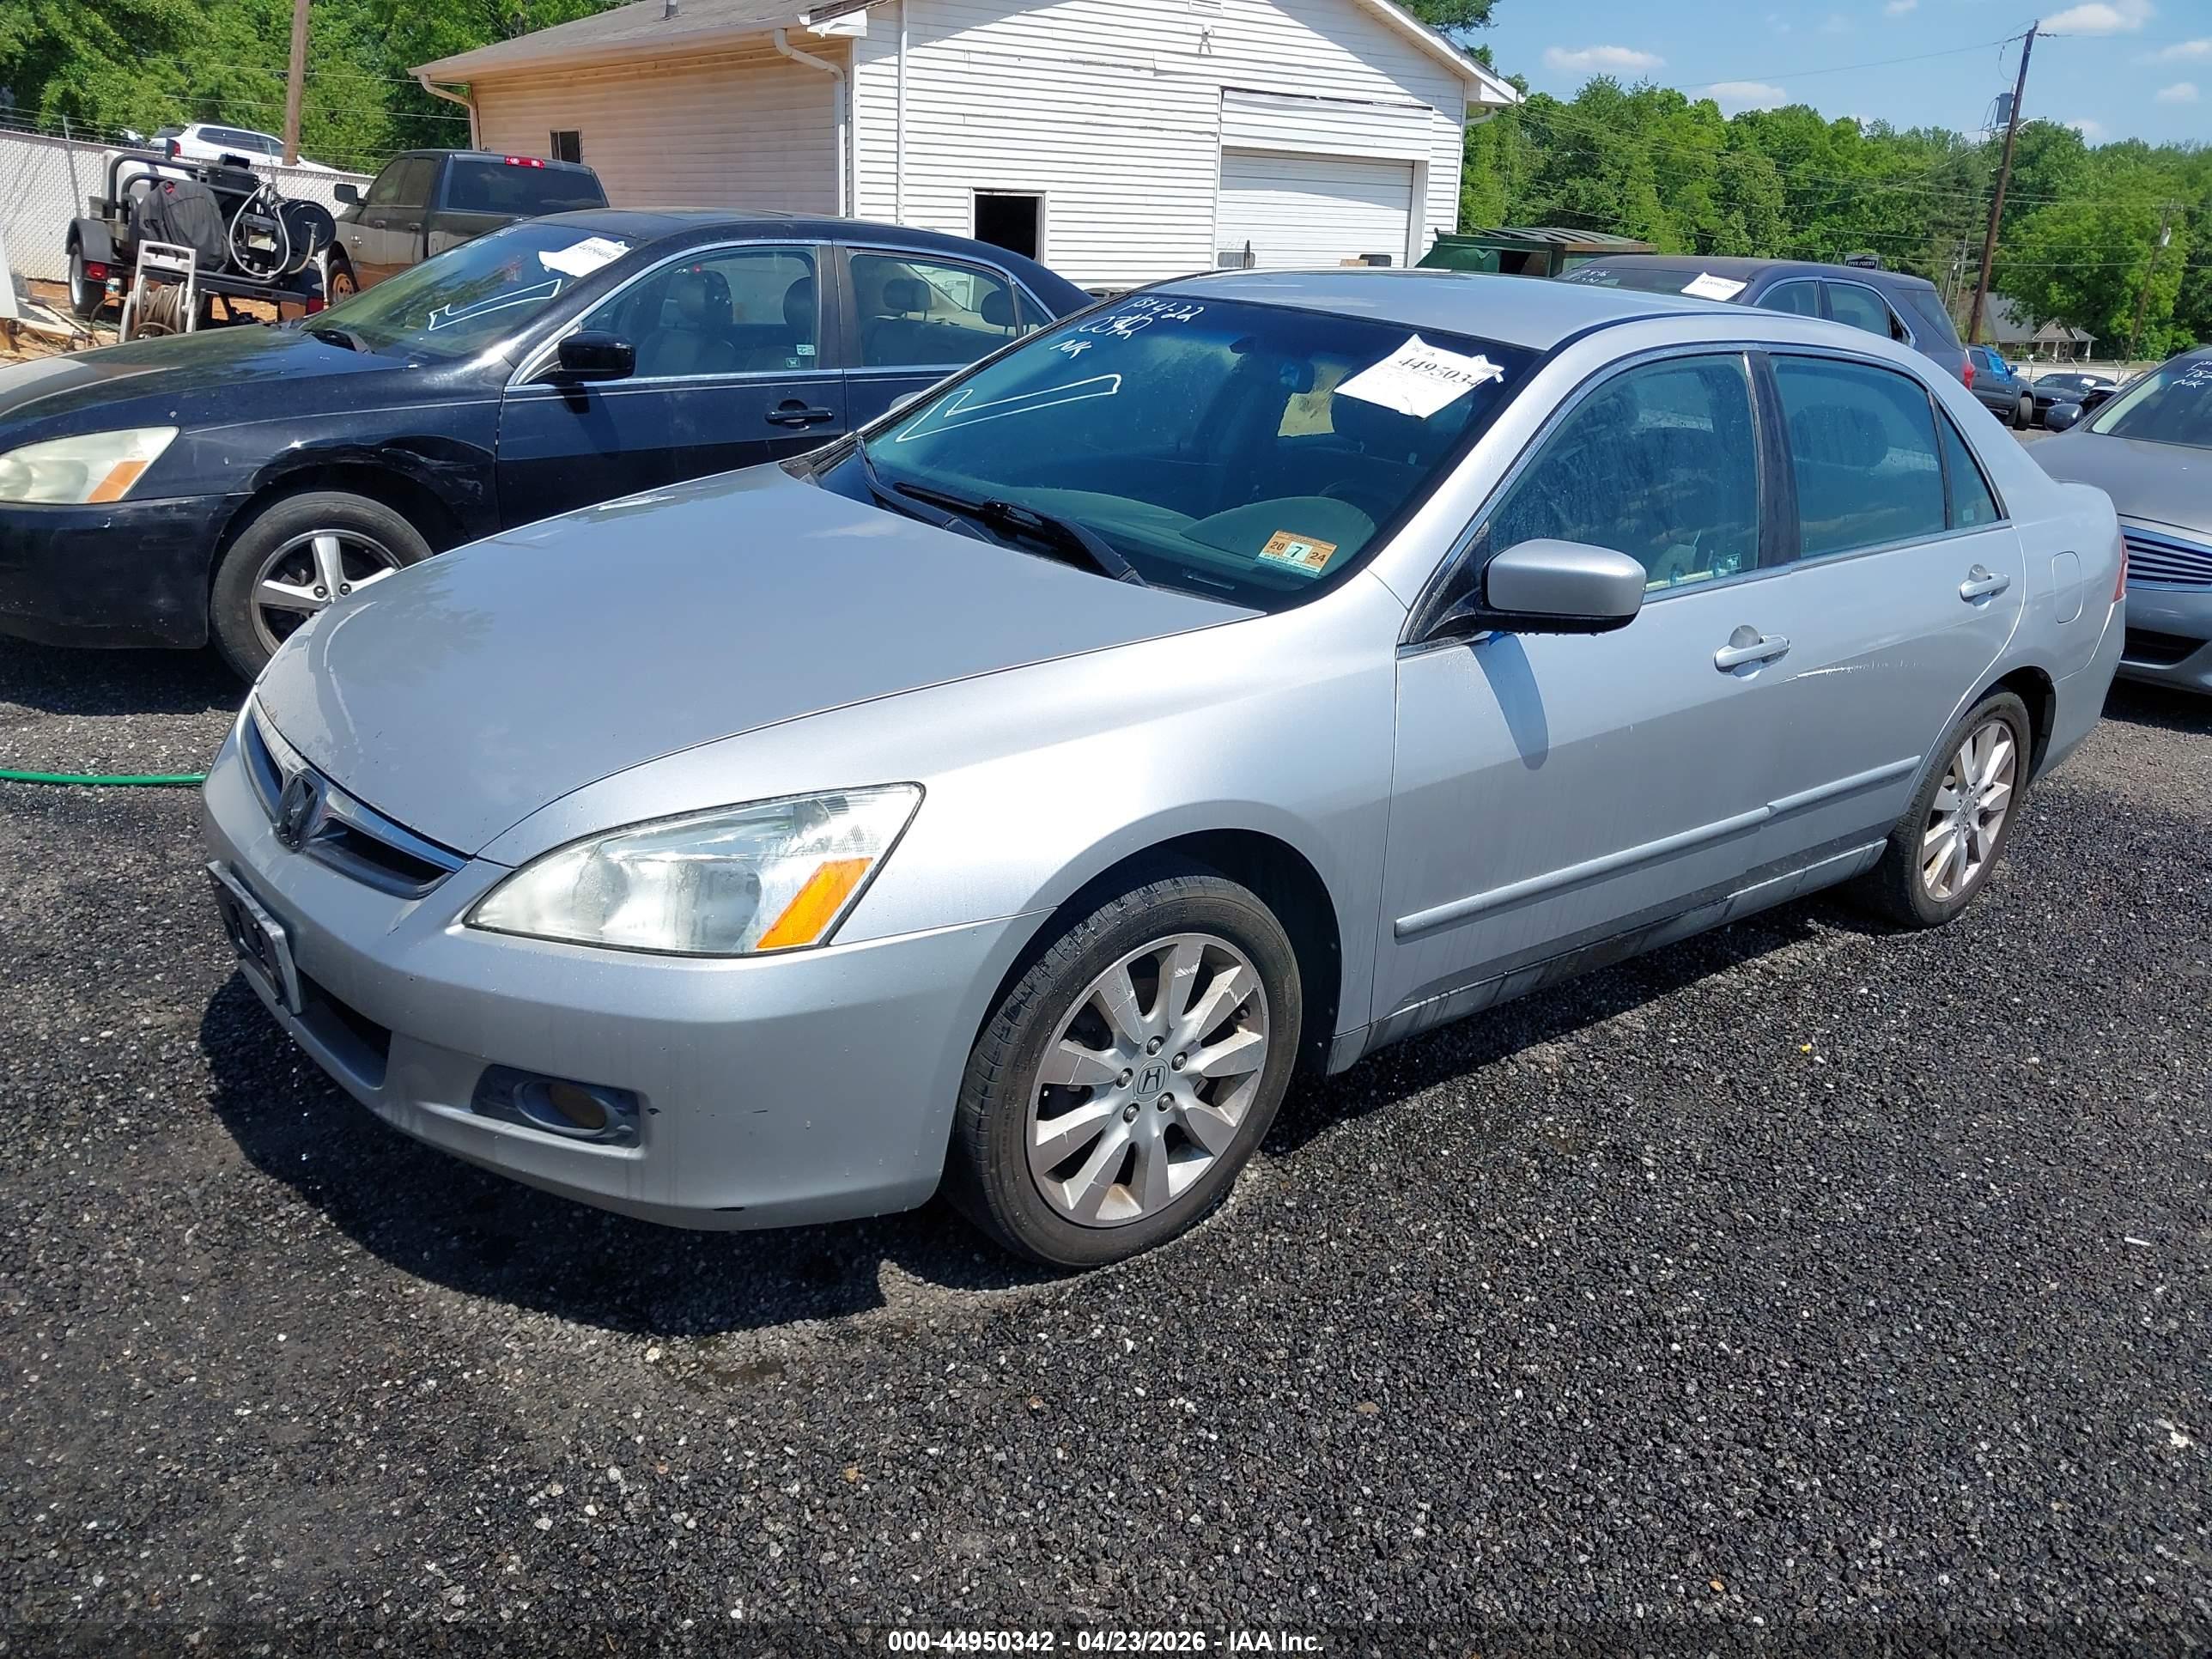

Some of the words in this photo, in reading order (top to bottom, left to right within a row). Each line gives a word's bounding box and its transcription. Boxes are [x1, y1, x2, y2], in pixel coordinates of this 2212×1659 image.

[1270, 541, 1285, 551] 20
[1290, 545, 1304, 557] 7
[1310, 552, 1327, 562] 24
